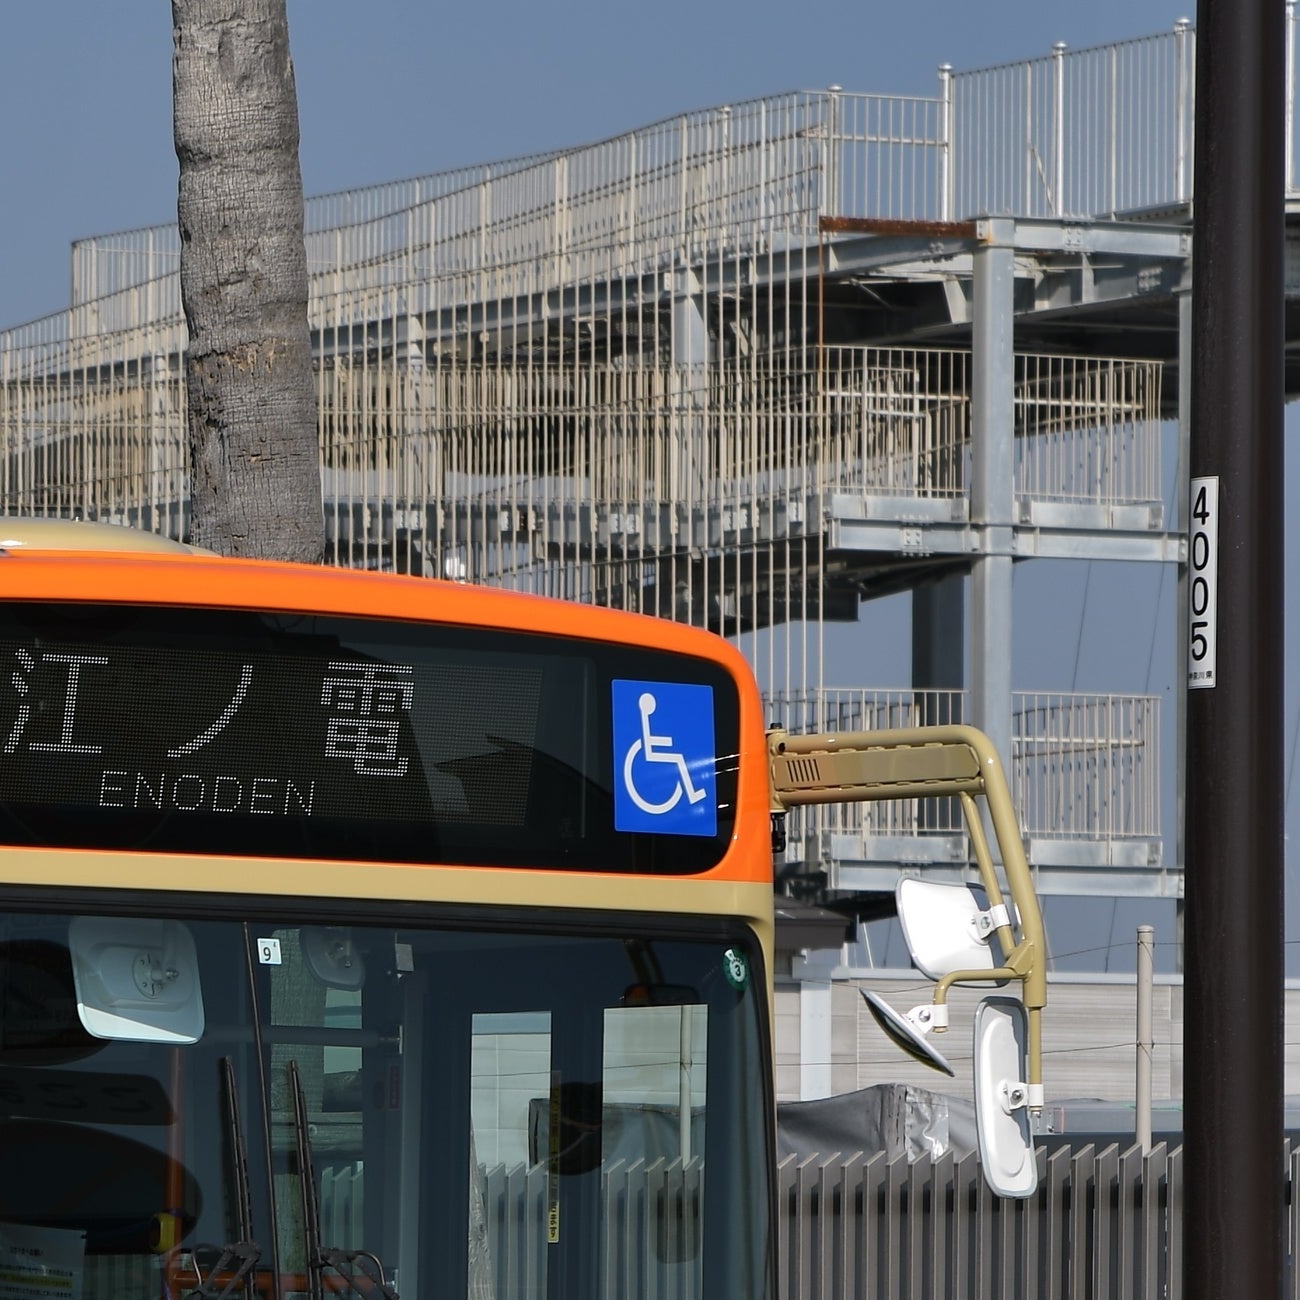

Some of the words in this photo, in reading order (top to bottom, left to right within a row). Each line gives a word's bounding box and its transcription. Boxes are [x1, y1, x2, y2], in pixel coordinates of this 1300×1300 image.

[1192, 486, 1209, 661] 4005
[4, 648, 415, 777] 江ノ電
[99, 770, 315, 816] ENODEN
[263, 946, 272, 962] 9
